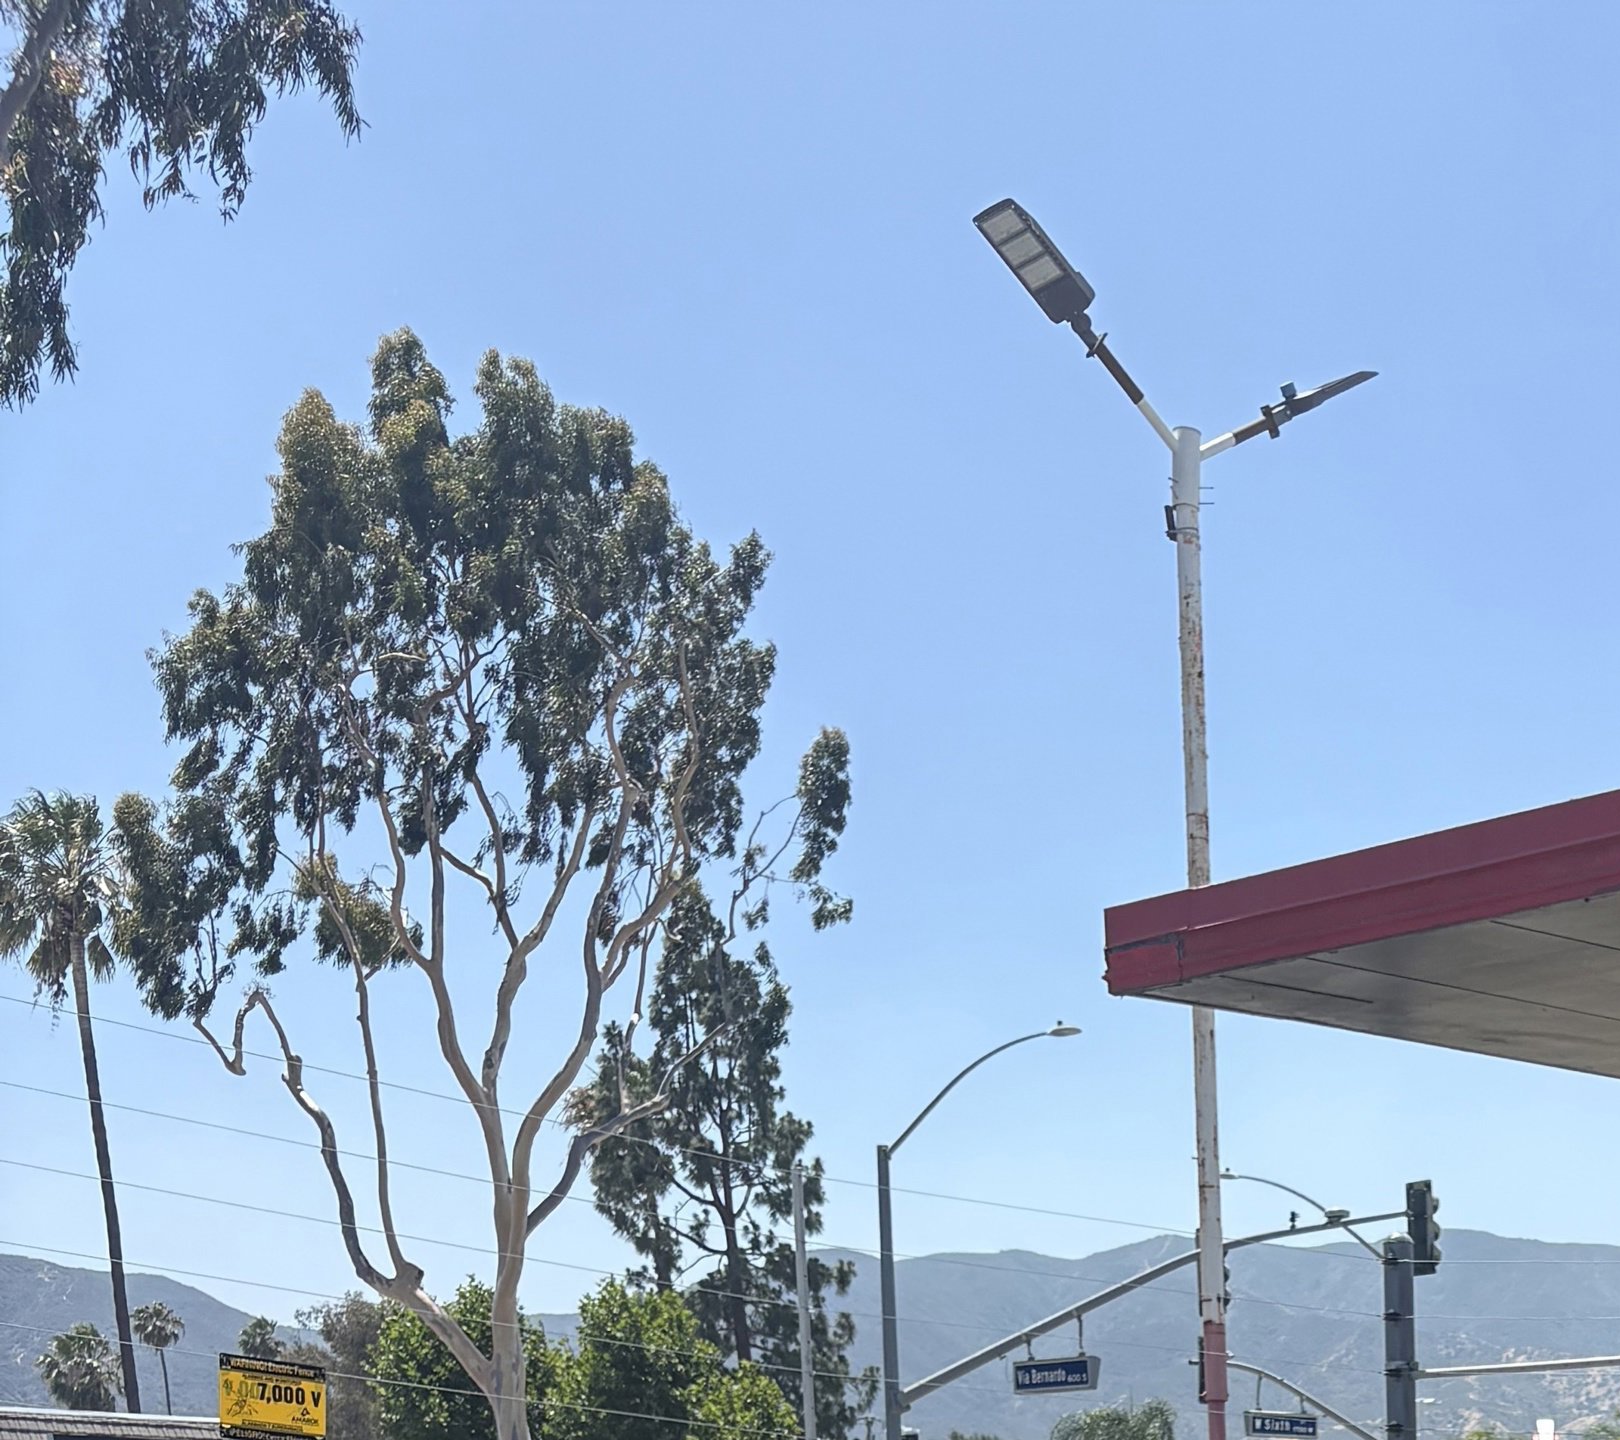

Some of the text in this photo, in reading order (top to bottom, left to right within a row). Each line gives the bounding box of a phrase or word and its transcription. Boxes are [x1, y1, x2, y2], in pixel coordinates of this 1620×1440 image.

[1017, 1369, 1030, 1385] Via
[1031, 1367, 1066, 1384] Bernardo
[257, 1382, 321, 1408] 7,000 V
[1263, 1418, 1291, 1432] Sixth
